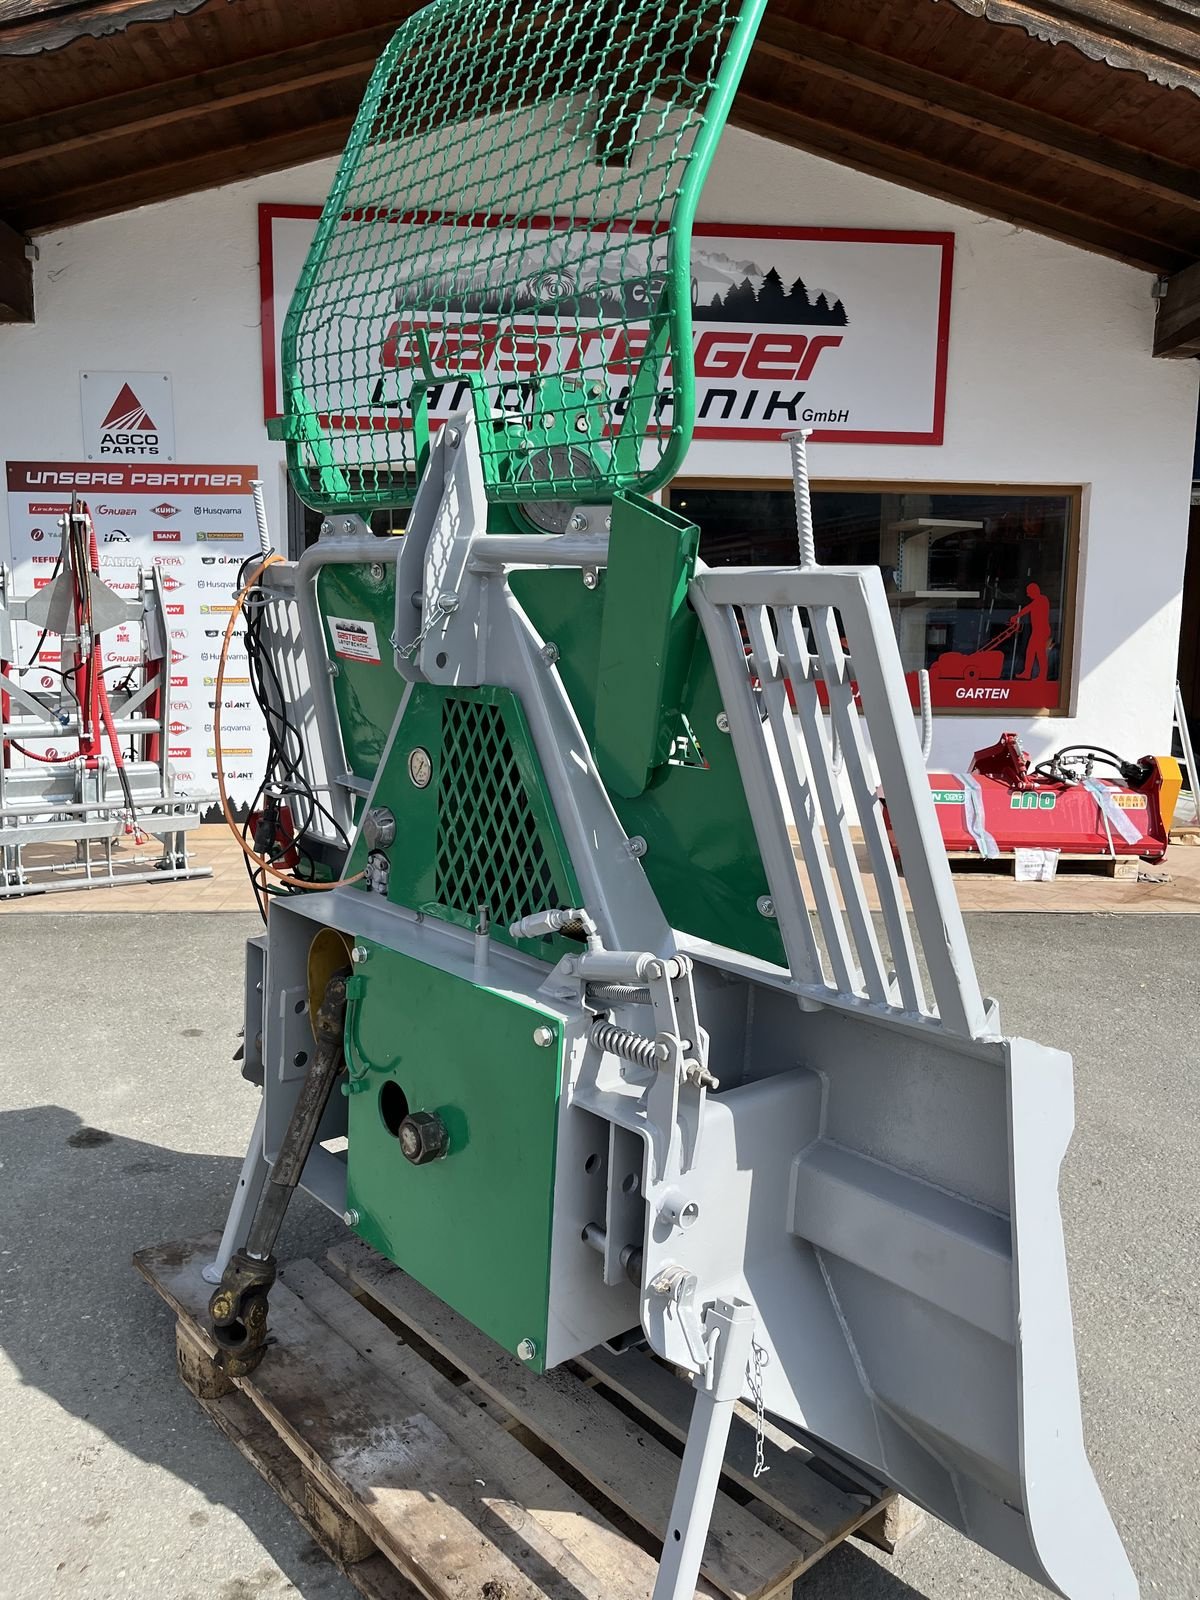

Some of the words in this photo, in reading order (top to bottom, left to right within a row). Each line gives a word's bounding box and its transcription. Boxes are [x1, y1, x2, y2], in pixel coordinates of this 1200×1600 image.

[802, 409, 849, 422] GmbH
[101, 434, 158, 445] AGCO
[101, 447, 158, 455] PARTS
[203, 507, 242, 515] Husqvarna
[218, 556, 244, 564] GIANT
[956, 688, 1010, 699] GARTEN
